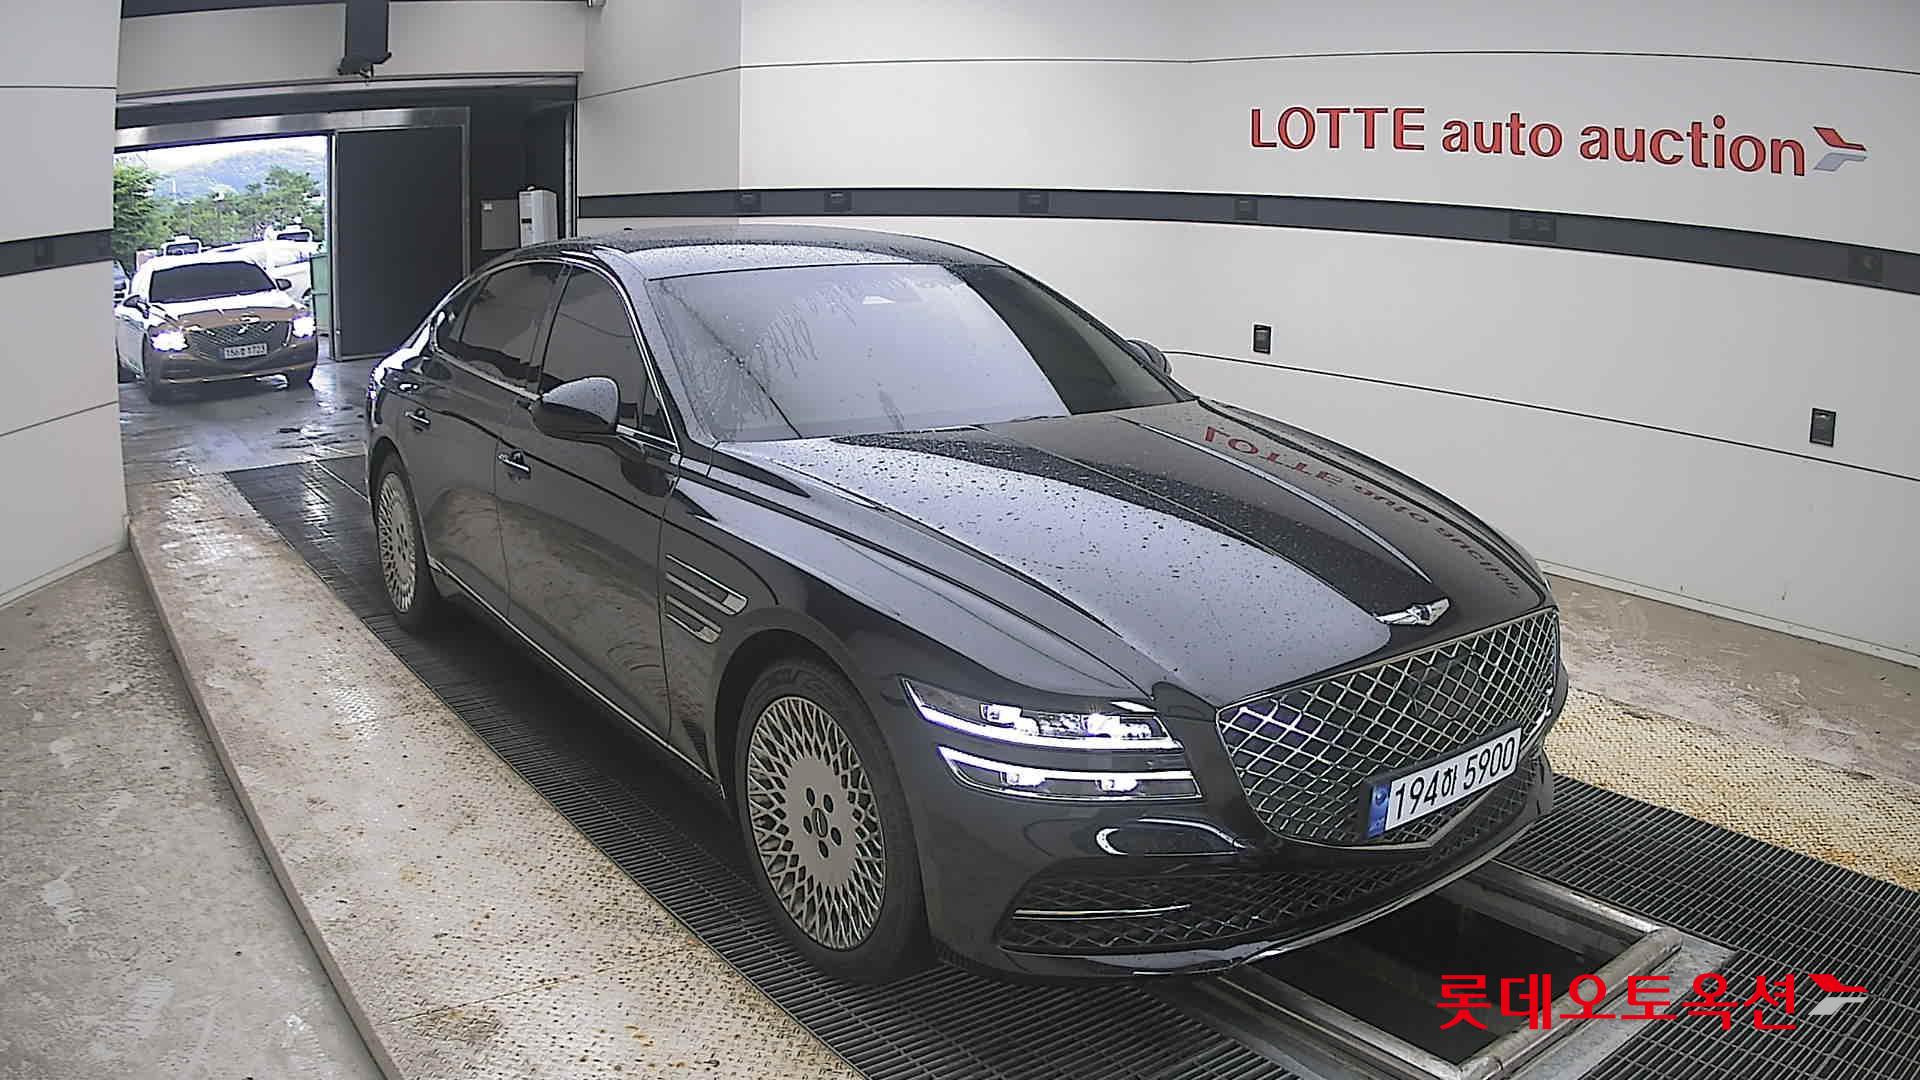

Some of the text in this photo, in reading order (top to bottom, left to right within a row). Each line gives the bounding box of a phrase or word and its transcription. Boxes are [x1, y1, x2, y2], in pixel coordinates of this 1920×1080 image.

[1251, 107, 1806, 176] LOTTE auto auction
[1395, 736, 1516, 820] 194하 5900
